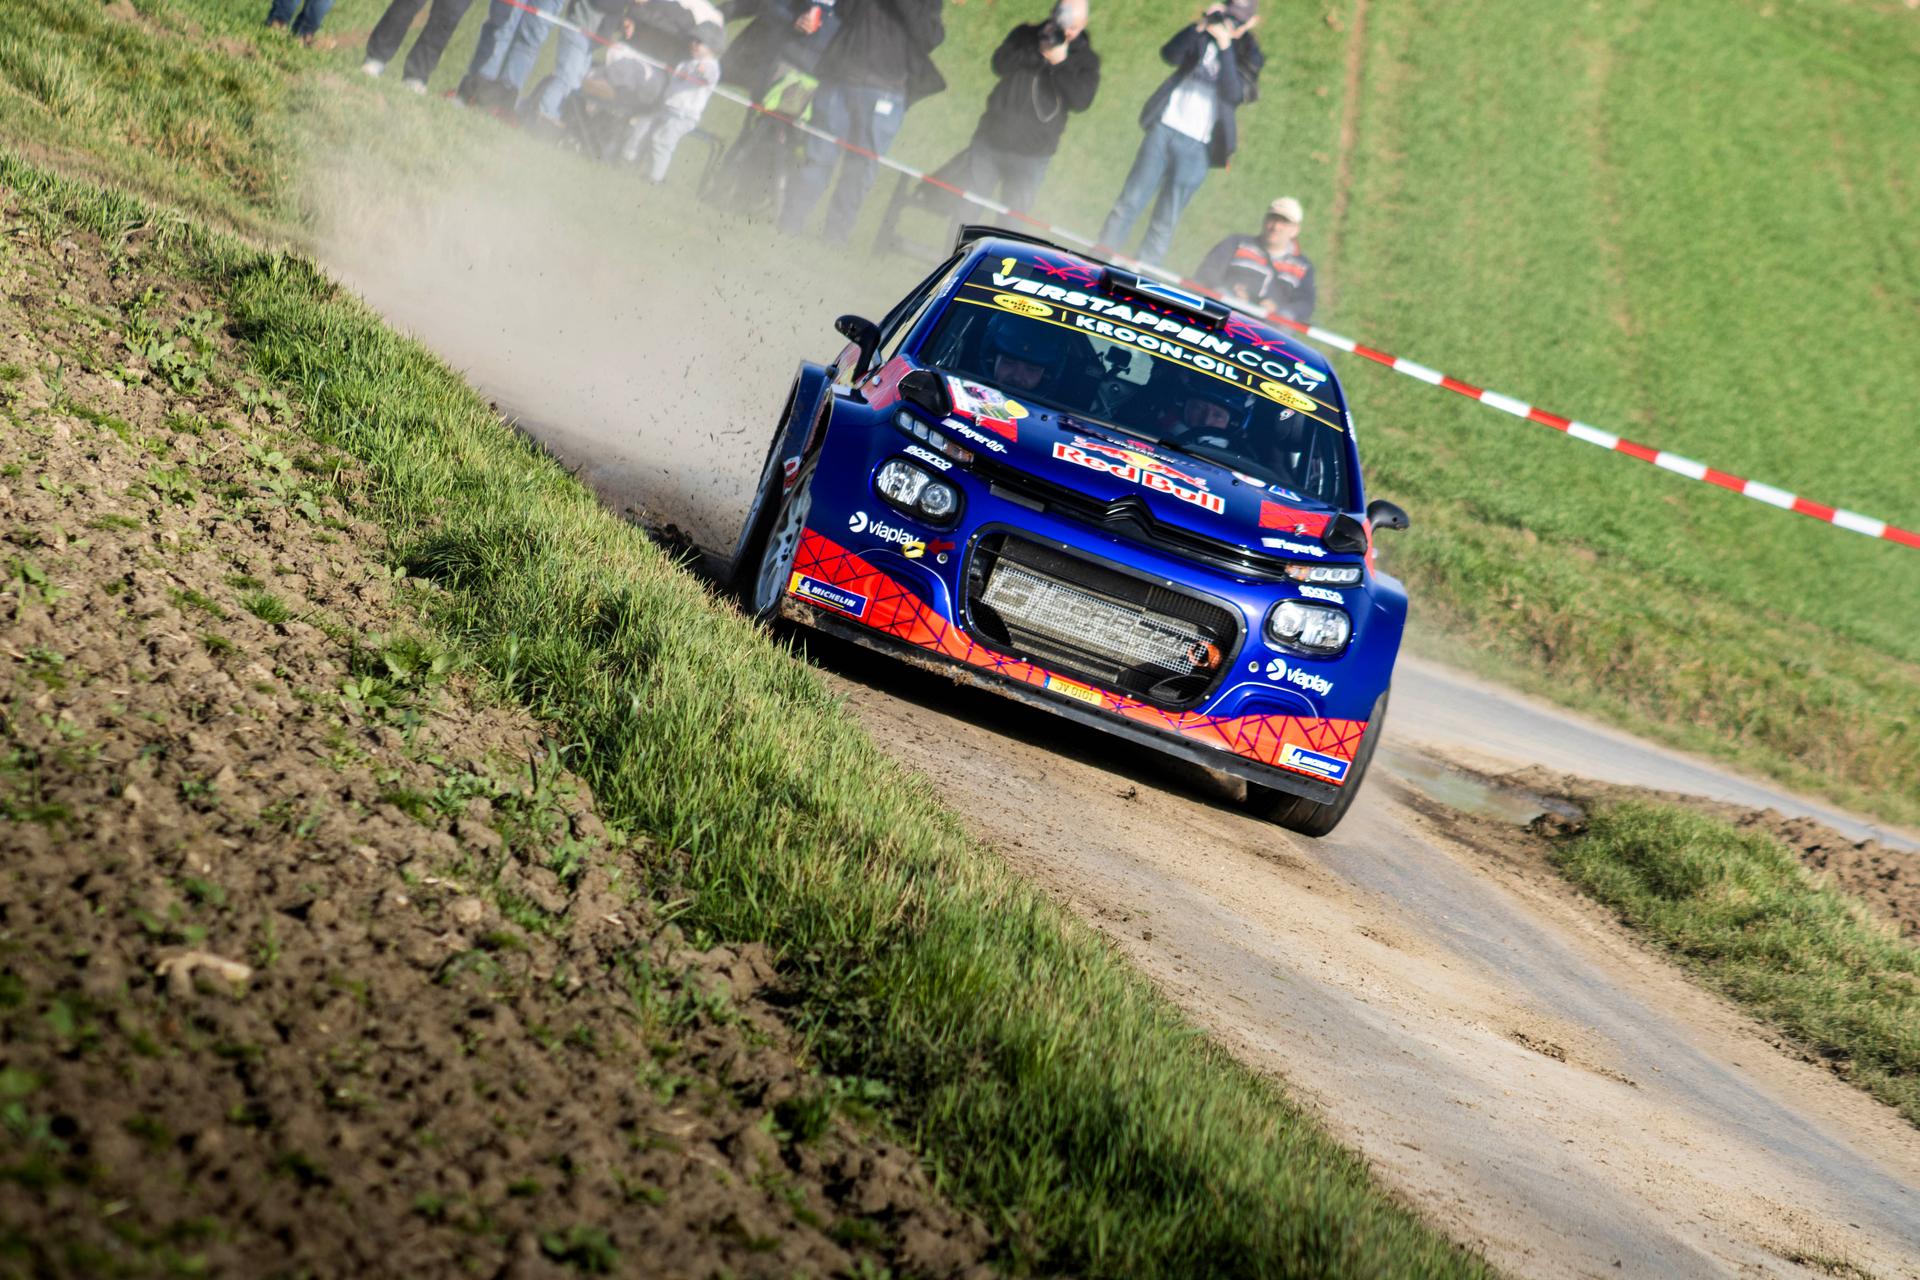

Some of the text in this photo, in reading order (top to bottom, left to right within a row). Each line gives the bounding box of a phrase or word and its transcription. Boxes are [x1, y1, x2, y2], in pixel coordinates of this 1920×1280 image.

[1000, 257, 1017, 276] 1
[992, 272, 1319, 392] VERSTAPPEN.COM
[1075, 314, 1239, 381] KROON-OIL
[903, 445, 953, 471] sparco
[1053, 442, 1225, 515] Red Bull
[869, 521, 919, 545] viaplay
[811, 586, 857, 607] MICHELIN
[1287, 667, 1334, 697] viaplay
